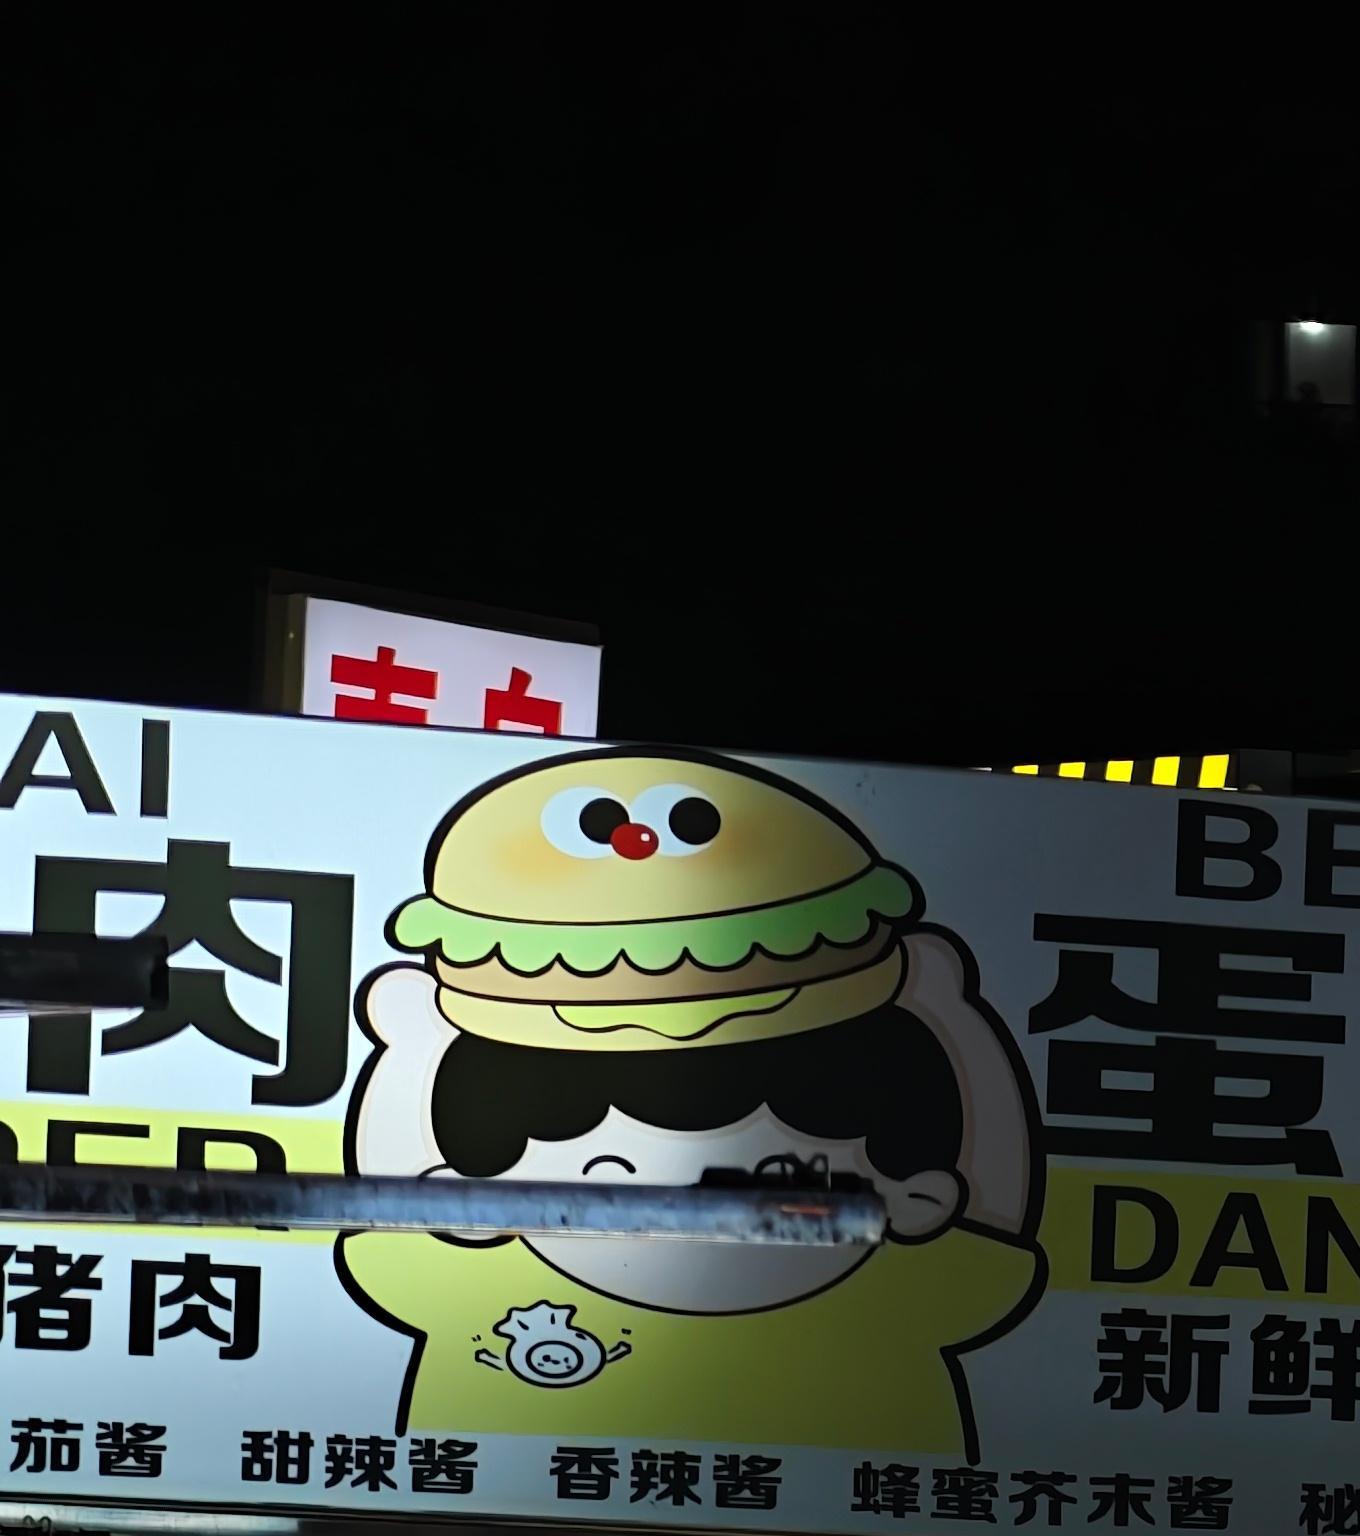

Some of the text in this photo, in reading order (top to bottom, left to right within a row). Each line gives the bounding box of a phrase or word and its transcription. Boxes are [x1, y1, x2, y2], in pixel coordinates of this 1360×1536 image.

[0, 710, 171, 819] AI
[0, 1244, 263, 1361] 猪肉
[10, 1417, 168, 1480] 茄酱
[240, 1429, 479, 1494] 甜辣酱
[550, 1444, 782, 1510] 香辣酱
[851, 1460, 1234, 1532] 蜂蜜芥末酱
